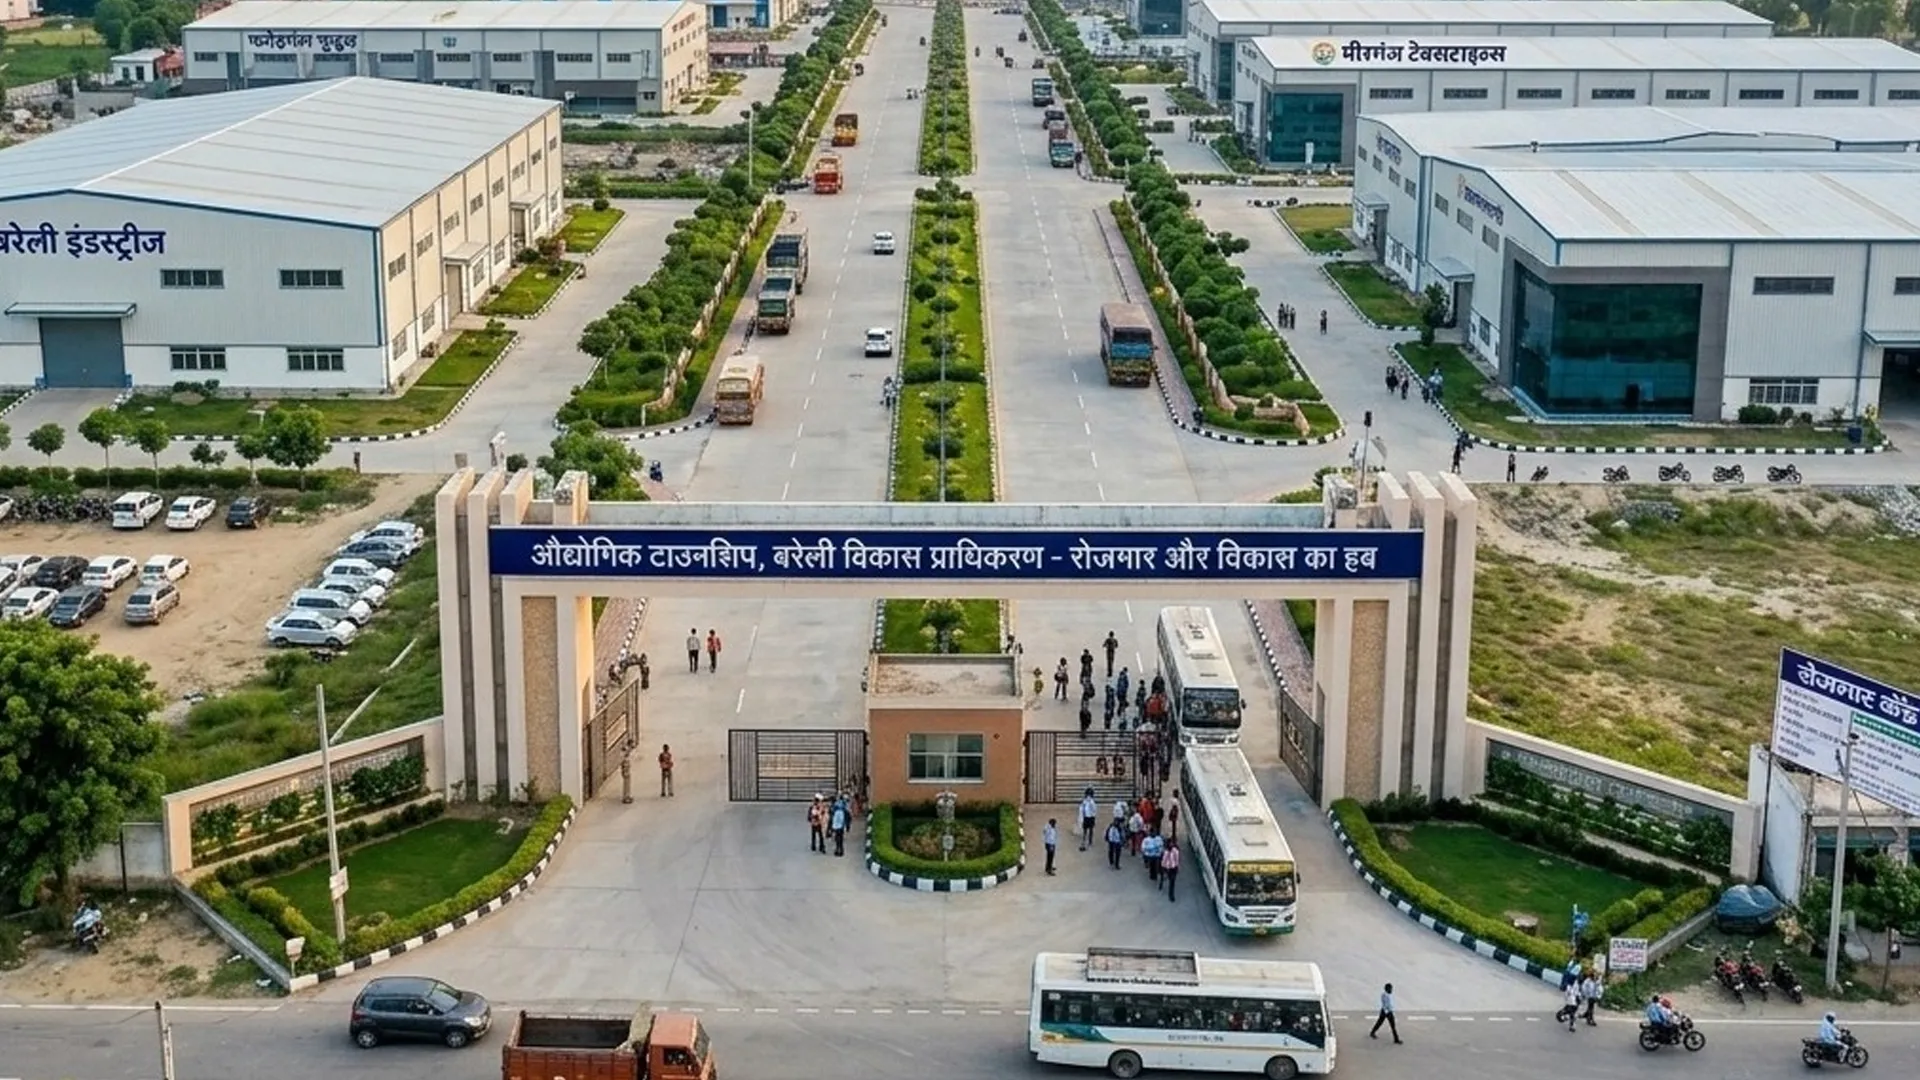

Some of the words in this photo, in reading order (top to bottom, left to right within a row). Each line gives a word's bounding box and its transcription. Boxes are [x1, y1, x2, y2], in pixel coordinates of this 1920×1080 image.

[65, 223, 167, 261] इंडस्ट्रीज
[772, 537, 837, 569] बरेली
[842, 537, 922, 569] विकास
[929, 537, 1044, 569] प्राधिकरण
[1164, 537, 1211, 570] और
[1216, 538, 1298, 570] विकास
[1303, 547, 1338, 570] का
[1343, 547, 1378, 573] हब
